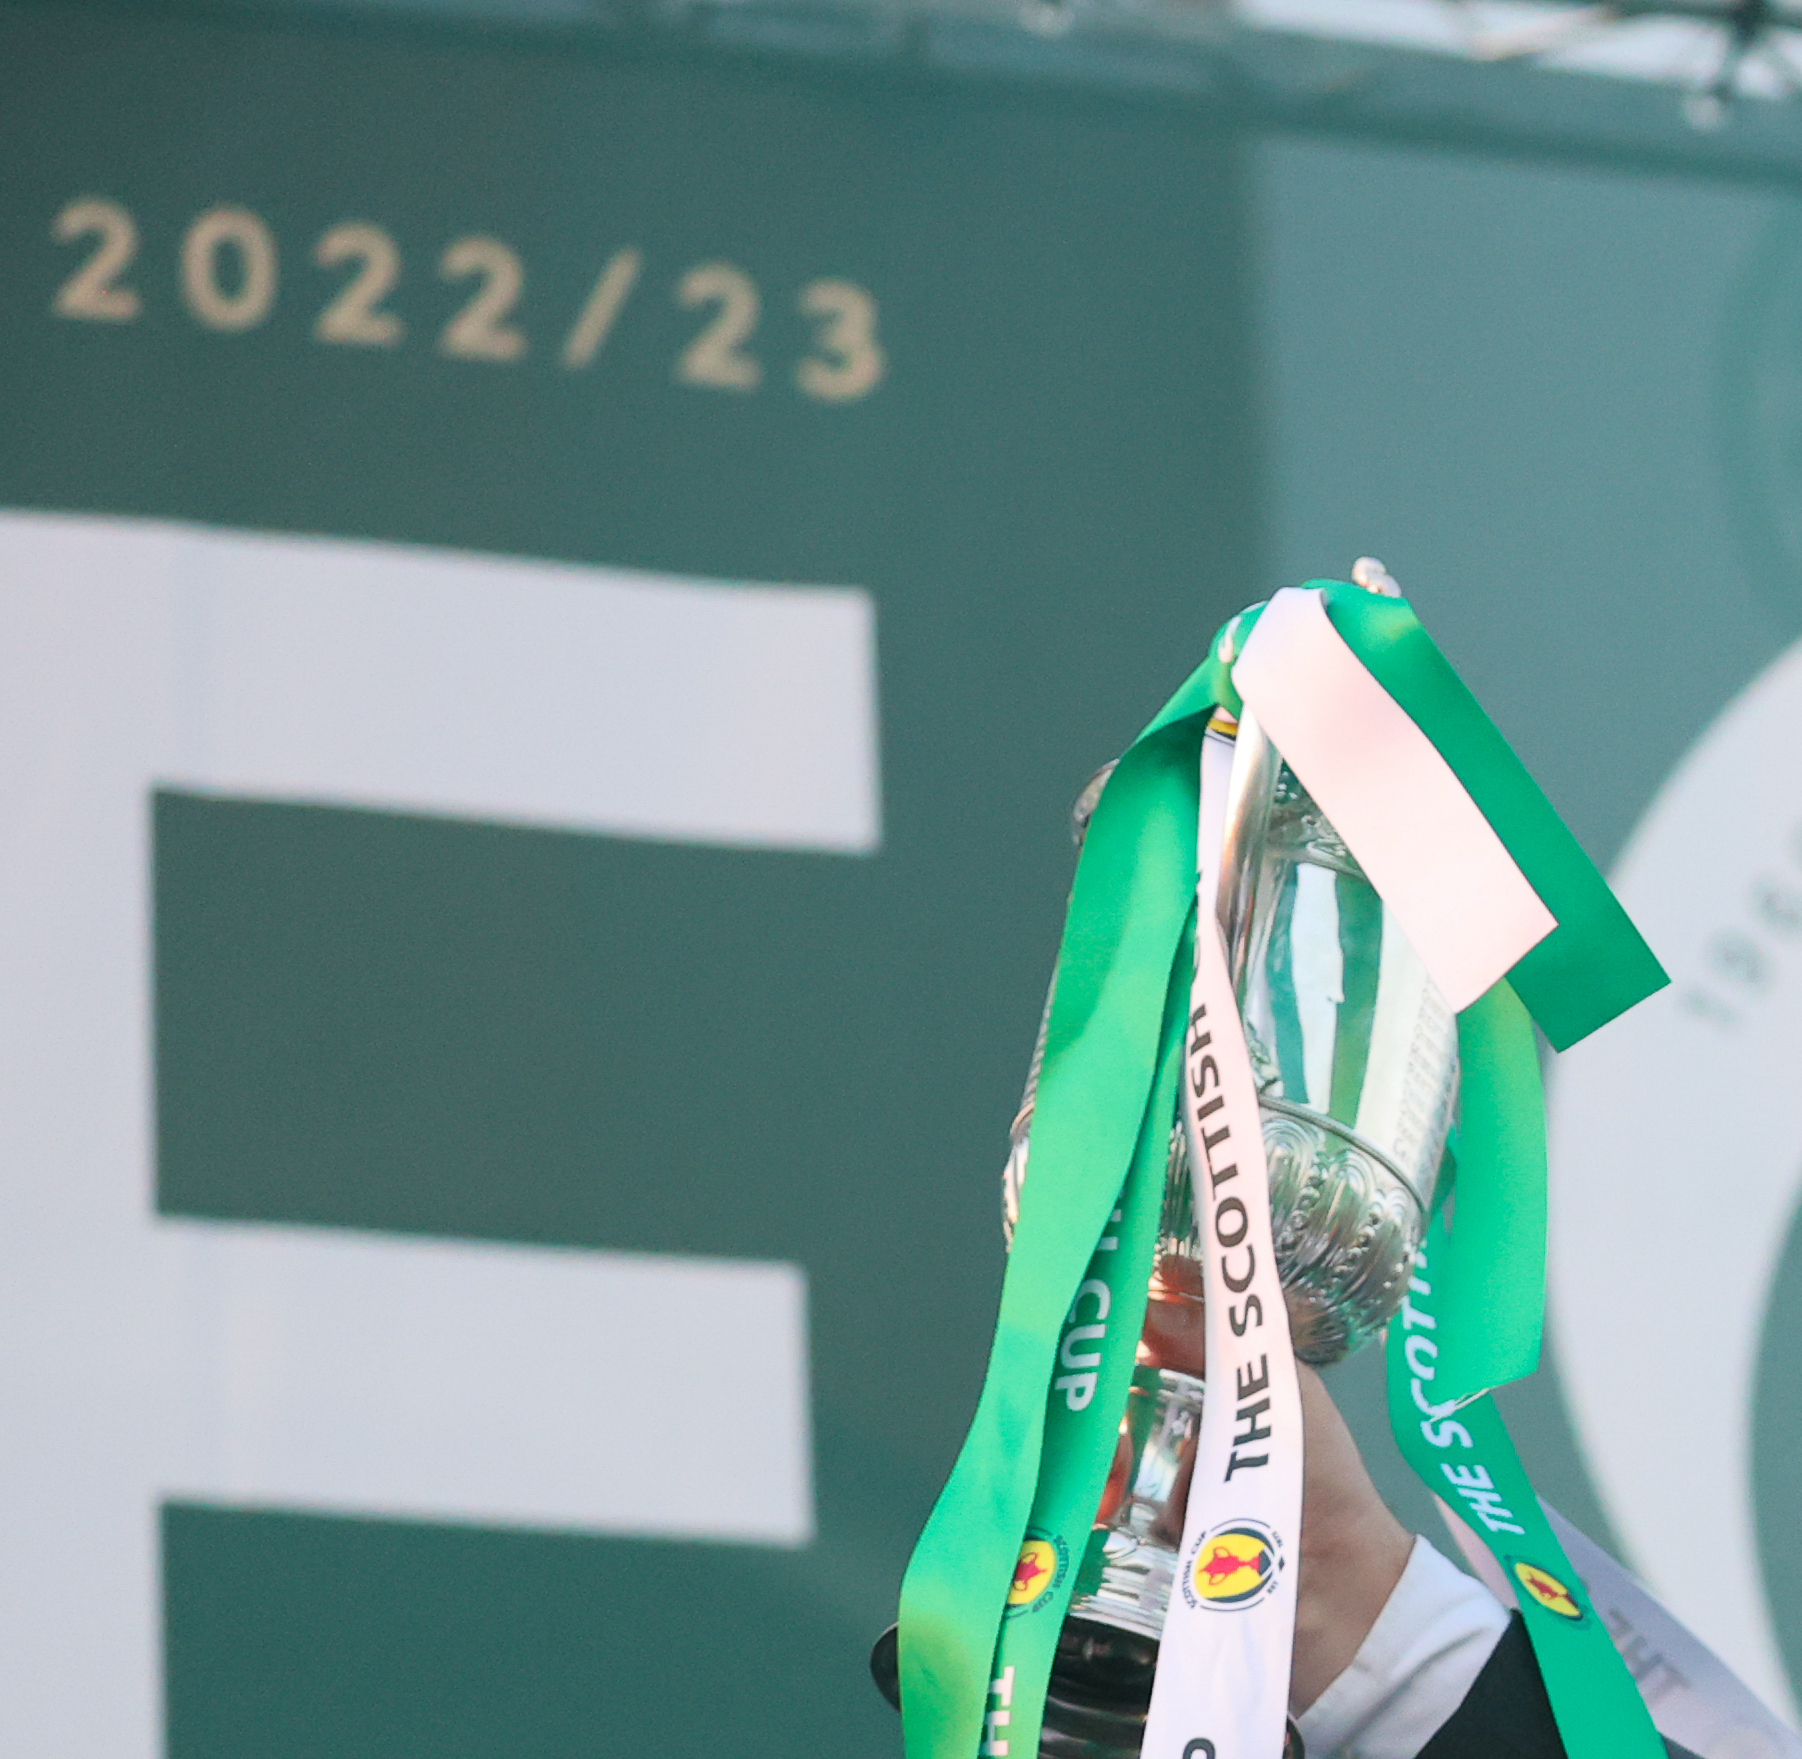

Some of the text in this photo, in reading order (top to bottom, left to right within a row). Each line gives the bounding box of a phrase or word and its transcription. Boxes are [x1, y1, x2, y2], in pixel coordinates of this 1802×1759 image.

[52, 197, 887, 402] 2022/23
[1188, 1003, 1273, 1483] THE SCOTTISH
[1054, 1278, 1111, 1412] CUP
[1438, 1462, 1526, 1536] THE
